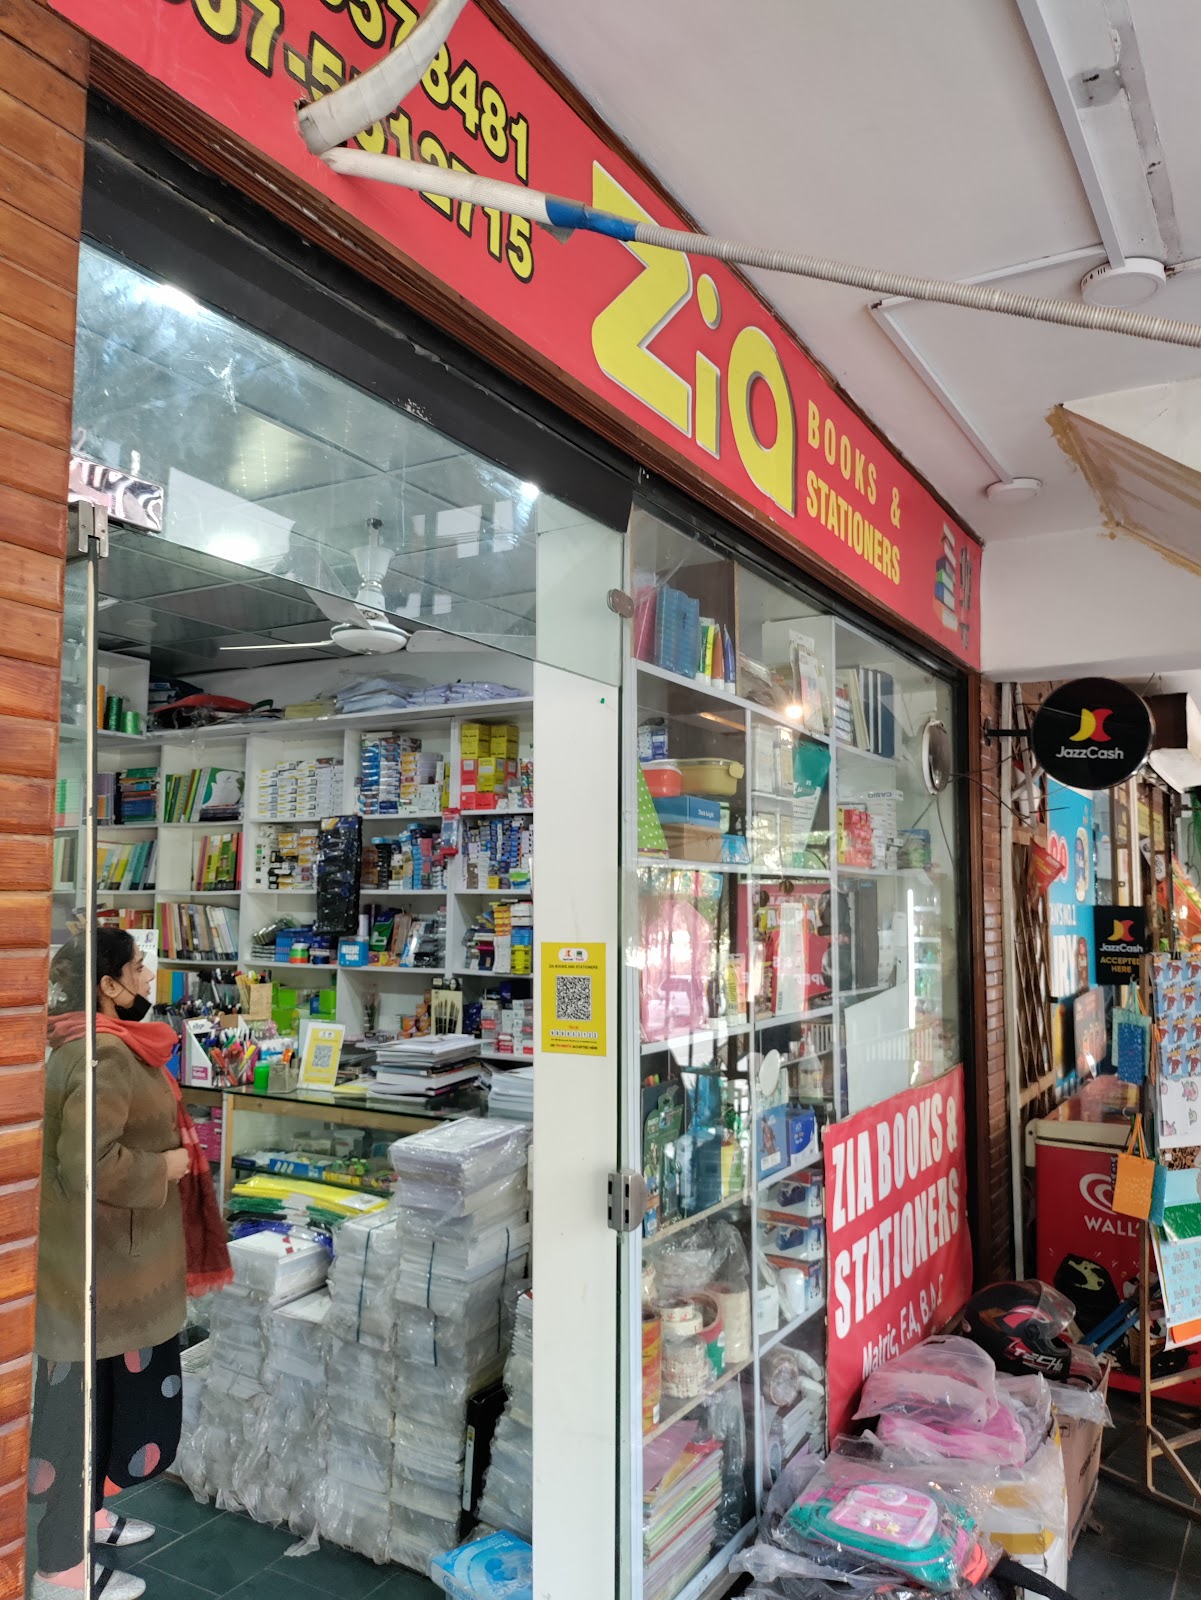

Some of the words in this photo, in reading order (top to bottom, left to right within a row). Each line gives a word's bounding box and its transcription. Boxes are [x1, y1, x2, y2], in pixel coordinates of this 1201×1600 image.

[807, 399, 877, 505] BOOKS
[890, 486, 901, 529] &
[806, 469, 900, 585] STATIONERS
[1055, 746, 1125, 760] JazzCash
[1099, 943, 1144, 953] JazzCash
[1111, 965, 1132, 973] HERE
[832, 1130, 874, 1233] ZIA
[876, 1092, 943, 1201] BOOKS
[946, 1096, 957, 1152] &
[834, 1168, 959, 1339] STATIONERS
